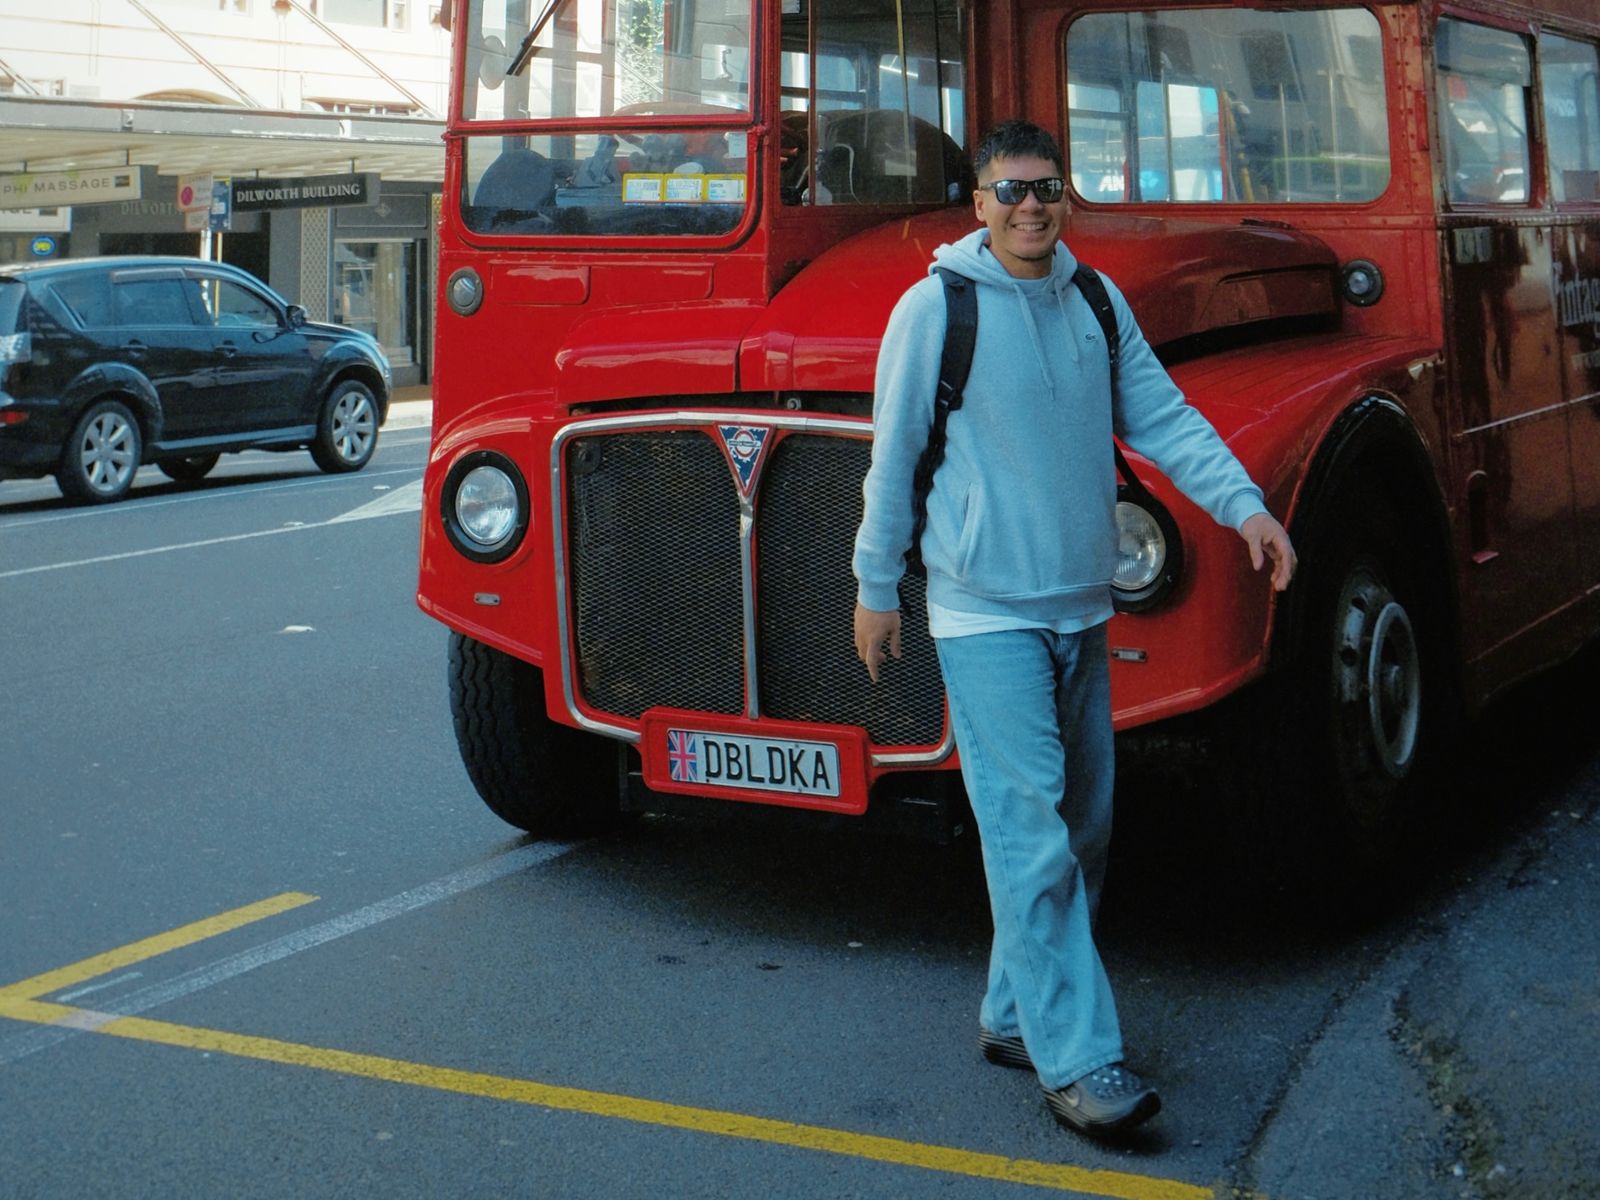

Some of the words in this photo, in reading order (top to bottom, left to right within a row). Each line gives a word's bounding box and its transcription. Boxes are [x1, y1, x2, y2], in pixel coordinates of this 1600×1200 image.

[34, 178, 110, 193] MASSAGE
[236, 188, 299, 203] DILWORTH
[302, 183, 361, 200] BUILDING
[703, 739, 831, 791] DBLDKA
